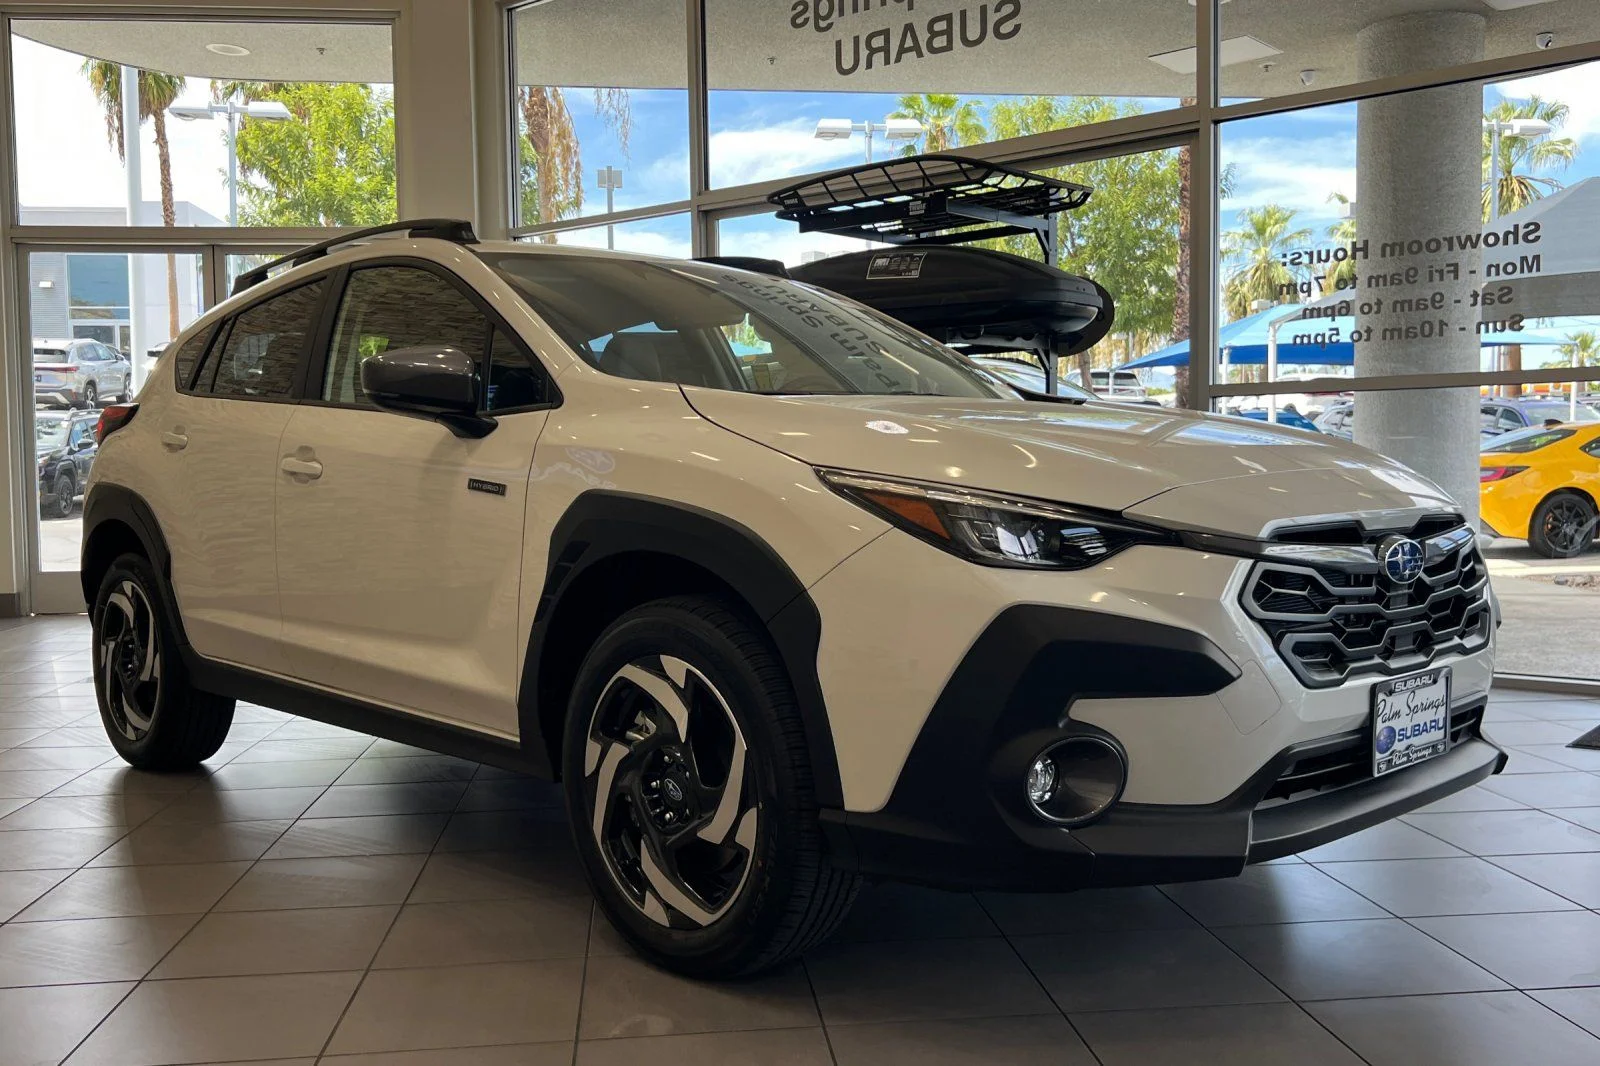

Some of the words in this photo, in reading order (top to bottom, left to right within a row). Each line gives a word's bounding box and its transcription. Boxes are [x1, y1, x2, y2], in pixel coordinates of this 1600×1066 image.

[1395, 674, 1433, 691] SUBARU
[1377, 699, 1401, 723] Palm
[1406, 690, 1445, 722] Springs
[1397, 717, 1445, 742] SUBARU
